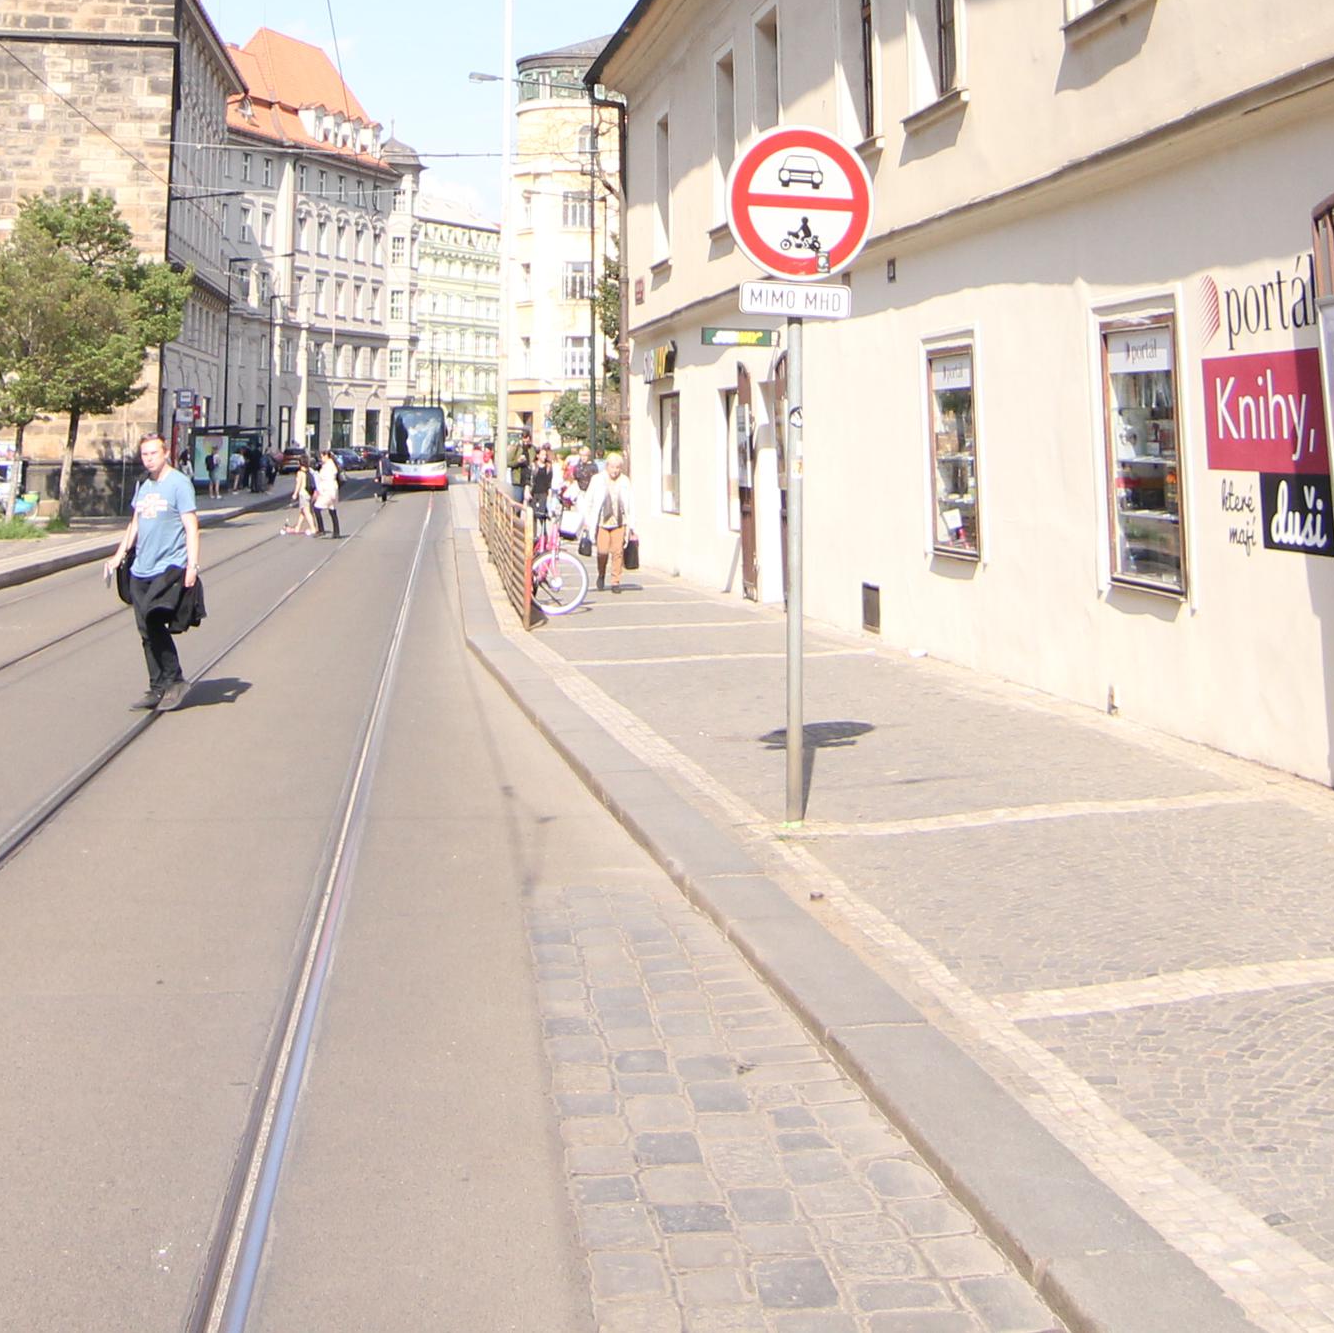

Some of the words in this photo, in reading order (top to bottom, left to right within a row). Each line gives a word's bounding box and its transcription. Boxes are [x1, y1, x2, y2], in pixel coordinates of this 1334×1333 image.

[750, 288, 796, 309] MIMO
[804, 291, 841, 312] MHD
[1224, 253, 1317, 351] portál
[1215, 369, 1316, 462] Knihy,
[1221, 478, 1255, 513] které
[1271, 480, 1327, 548] duši
[1229, 516, 1256, 557] mají
